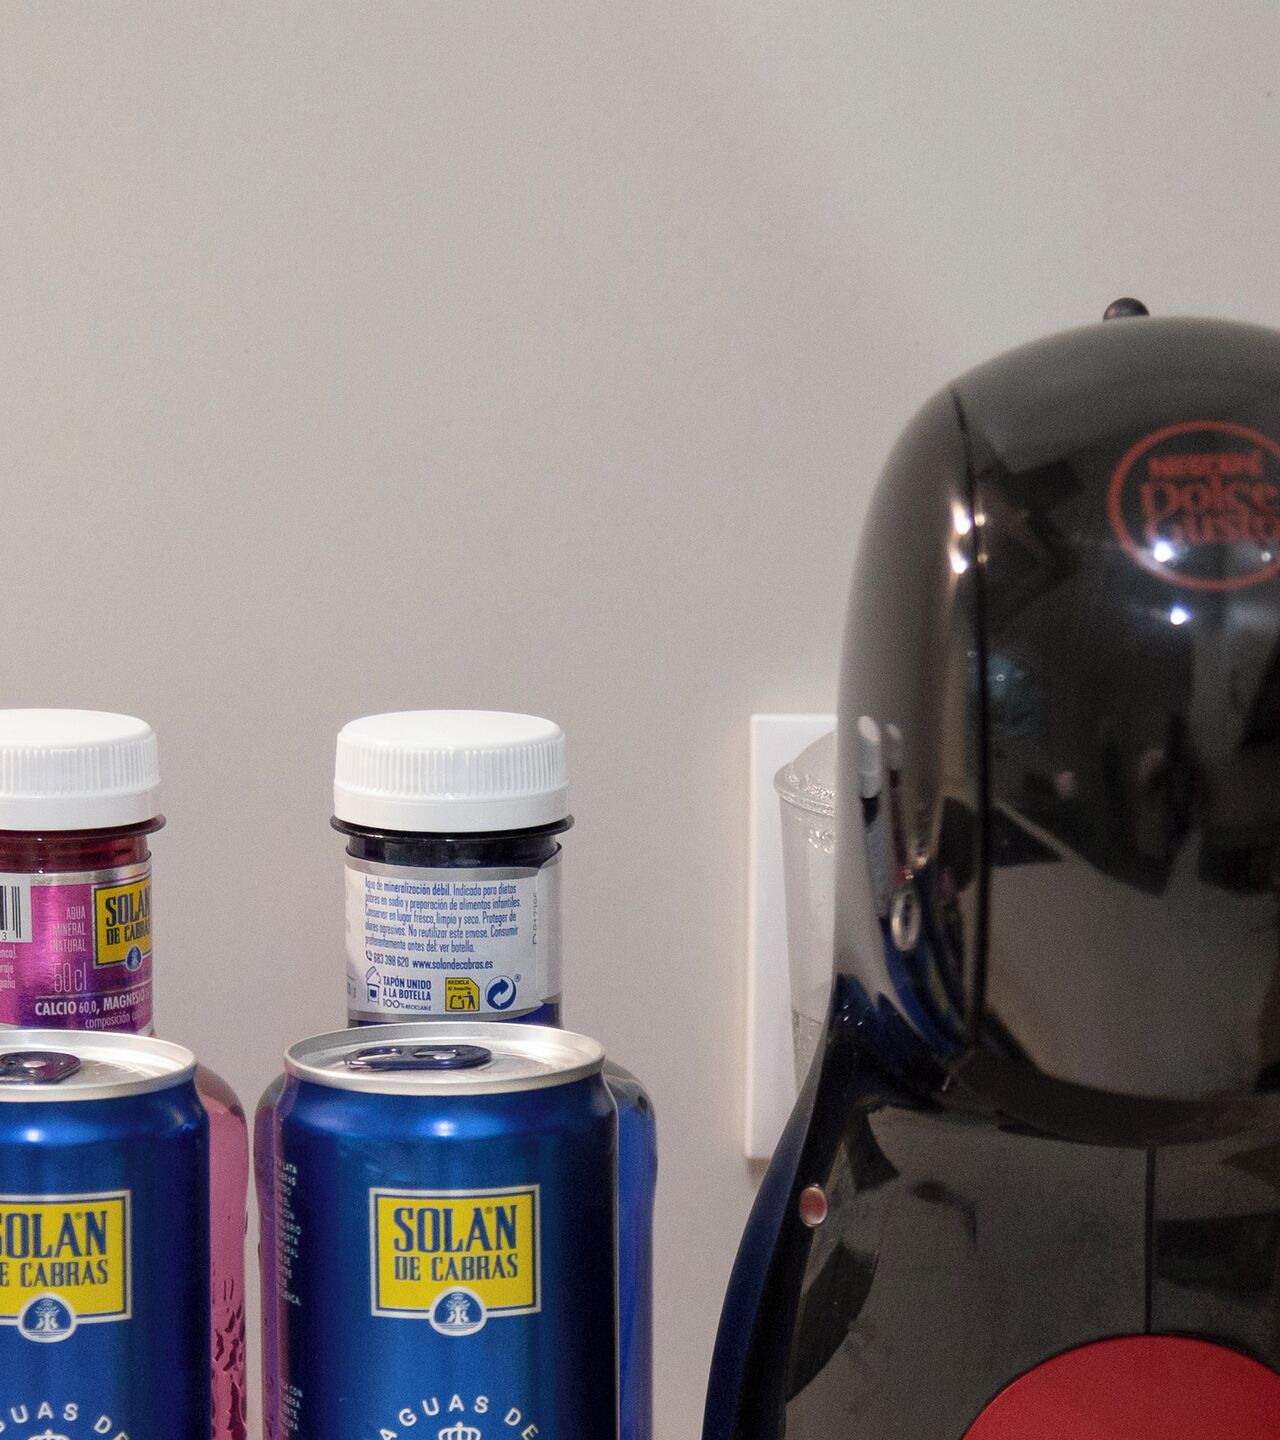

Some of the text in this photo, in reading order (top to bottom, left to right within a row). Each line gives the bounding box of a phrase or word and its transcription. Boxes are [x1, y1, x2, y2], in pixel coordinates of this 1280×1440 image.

[384, 881, 431, 895] mineralización
[498, 882, 517, 895] dietas
[410, 898, 448, 913] preparación
[449, 898, 457, 910] de
[459, 897, 491, 910] alimentos
[65, 906, 86, 920] AGUA
[436, 911, 457, 928] limpio
[458, 916, 463, 928] y
[482, 911, 508, 927] Proteger
[509, 909, 517, 922] de
[51, 920, 86, 937] MINERAL
[408, 924, 417, 937] No
[449, 928, 464, 939] este
[106, 927, 120, 946] DE
[51, 937, 87, 953] NATURAL
[407, 940, 425, 952] antes
[412, 957, 494, 970] www.solandecabras.es
[383, 975, 432, 990] TAPÓN UNIDO
[383, 987, 432, 1001] A LA BOTELLA
[35, 1001, 77, 1016] CALCIO
[20, 1258, 108, 1288] CABRAS
[394, 1253, 518, 1282] DE CABRAS
